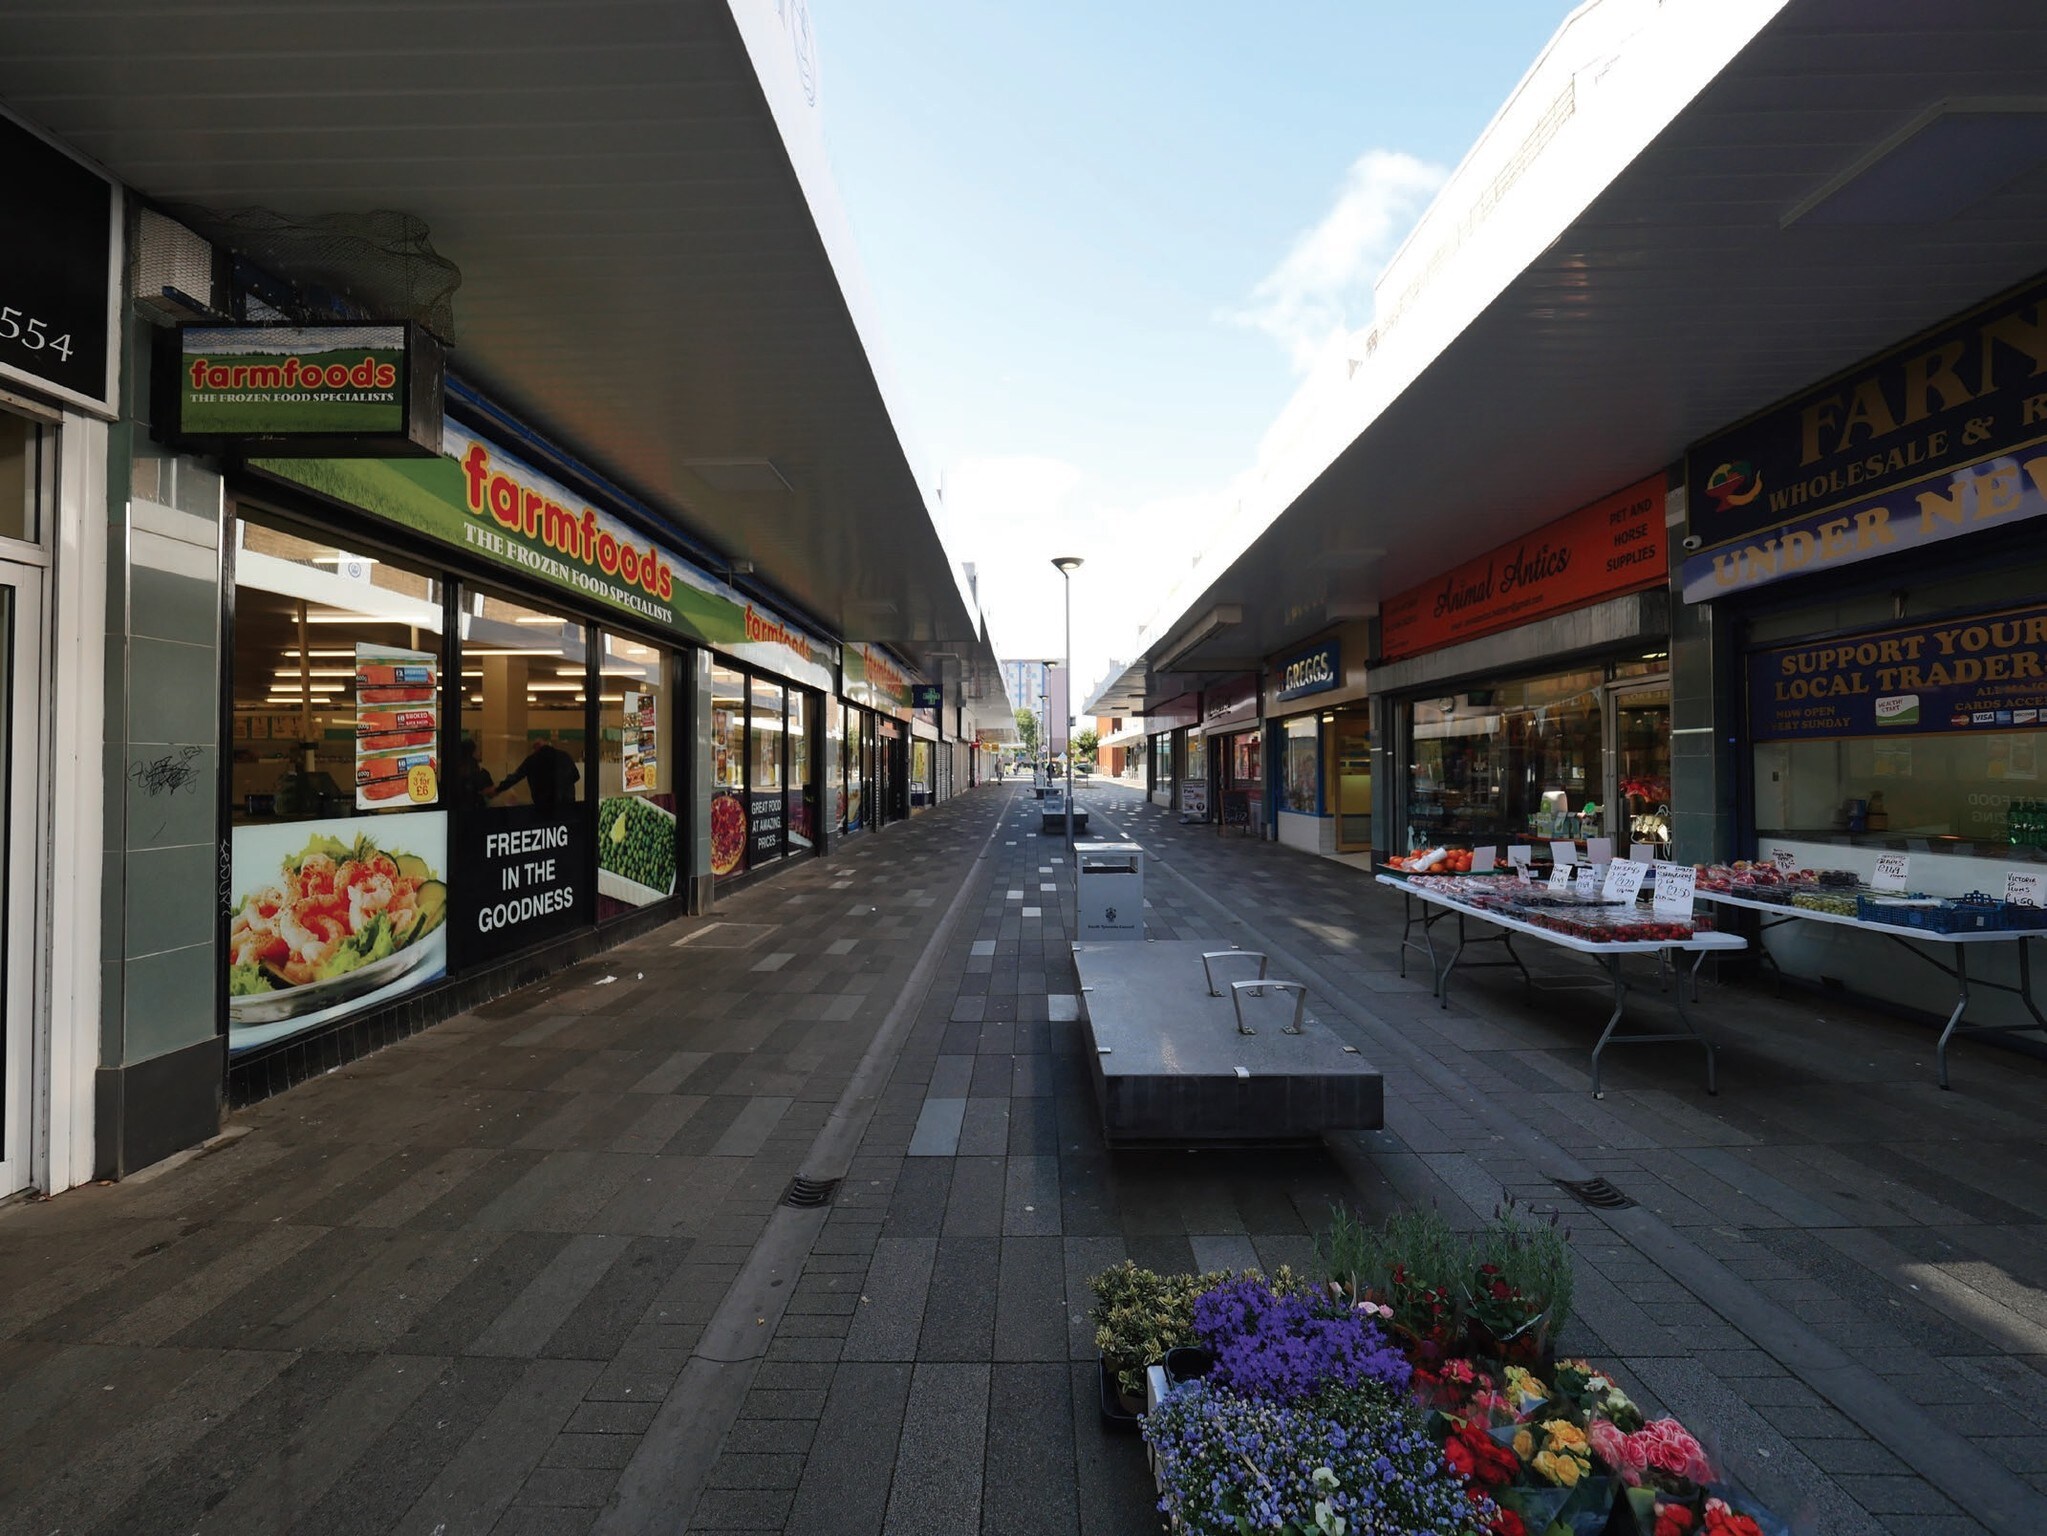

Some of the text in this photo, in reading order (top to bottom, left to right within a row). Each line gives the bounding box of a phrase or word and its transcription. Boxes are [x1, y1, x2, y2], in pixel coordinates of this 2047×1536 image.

[189, 357, 396, 390] farmfoods
[190, 392, 394, 403] THE FROZEN FOOD SPECIALISTS
[1768, 429, 1949, 513] WHOLESALE
[1962, 416, 1995, 445] &
[461, 440, 673, 602] farmfoods
[1609, 498, 1652, 526] PET AND
[1614, 523, 1648, 547] HORSE
[1712, 507, 1897, 588] UNDER
[464, 522, 672, 623] THE FROZEN FOOD SPECIALISTS
[1606, 544, 1656, 572] SUPPLIES
[1434, 561, 1494, 617] Animal
[1500, 544, 1572, 594] Antics
[744, 602, 811, 662] farmfoods
[1286, 651, 1329, 690] GREGGS
[1781, 635, 1925, 676] SUPPORT
[1775, 651, 2047, 702] LOCAL TRADER
[1802, 718, 1852, 729] SUNDAY
[1804, 706, 1836, 716] OPEN
[416, 787, 428, 796] £6
[751, 800, 781, 815] GREAT FOOD
[752, 816, 782, 833] AT AMAZING
[486, 825, 568, 858] FREEZING
[757, 835, 776, 850] PRICES
[502, 859, 556, 891] IN THE
[478, 886, 573, 933] GOODNESS
